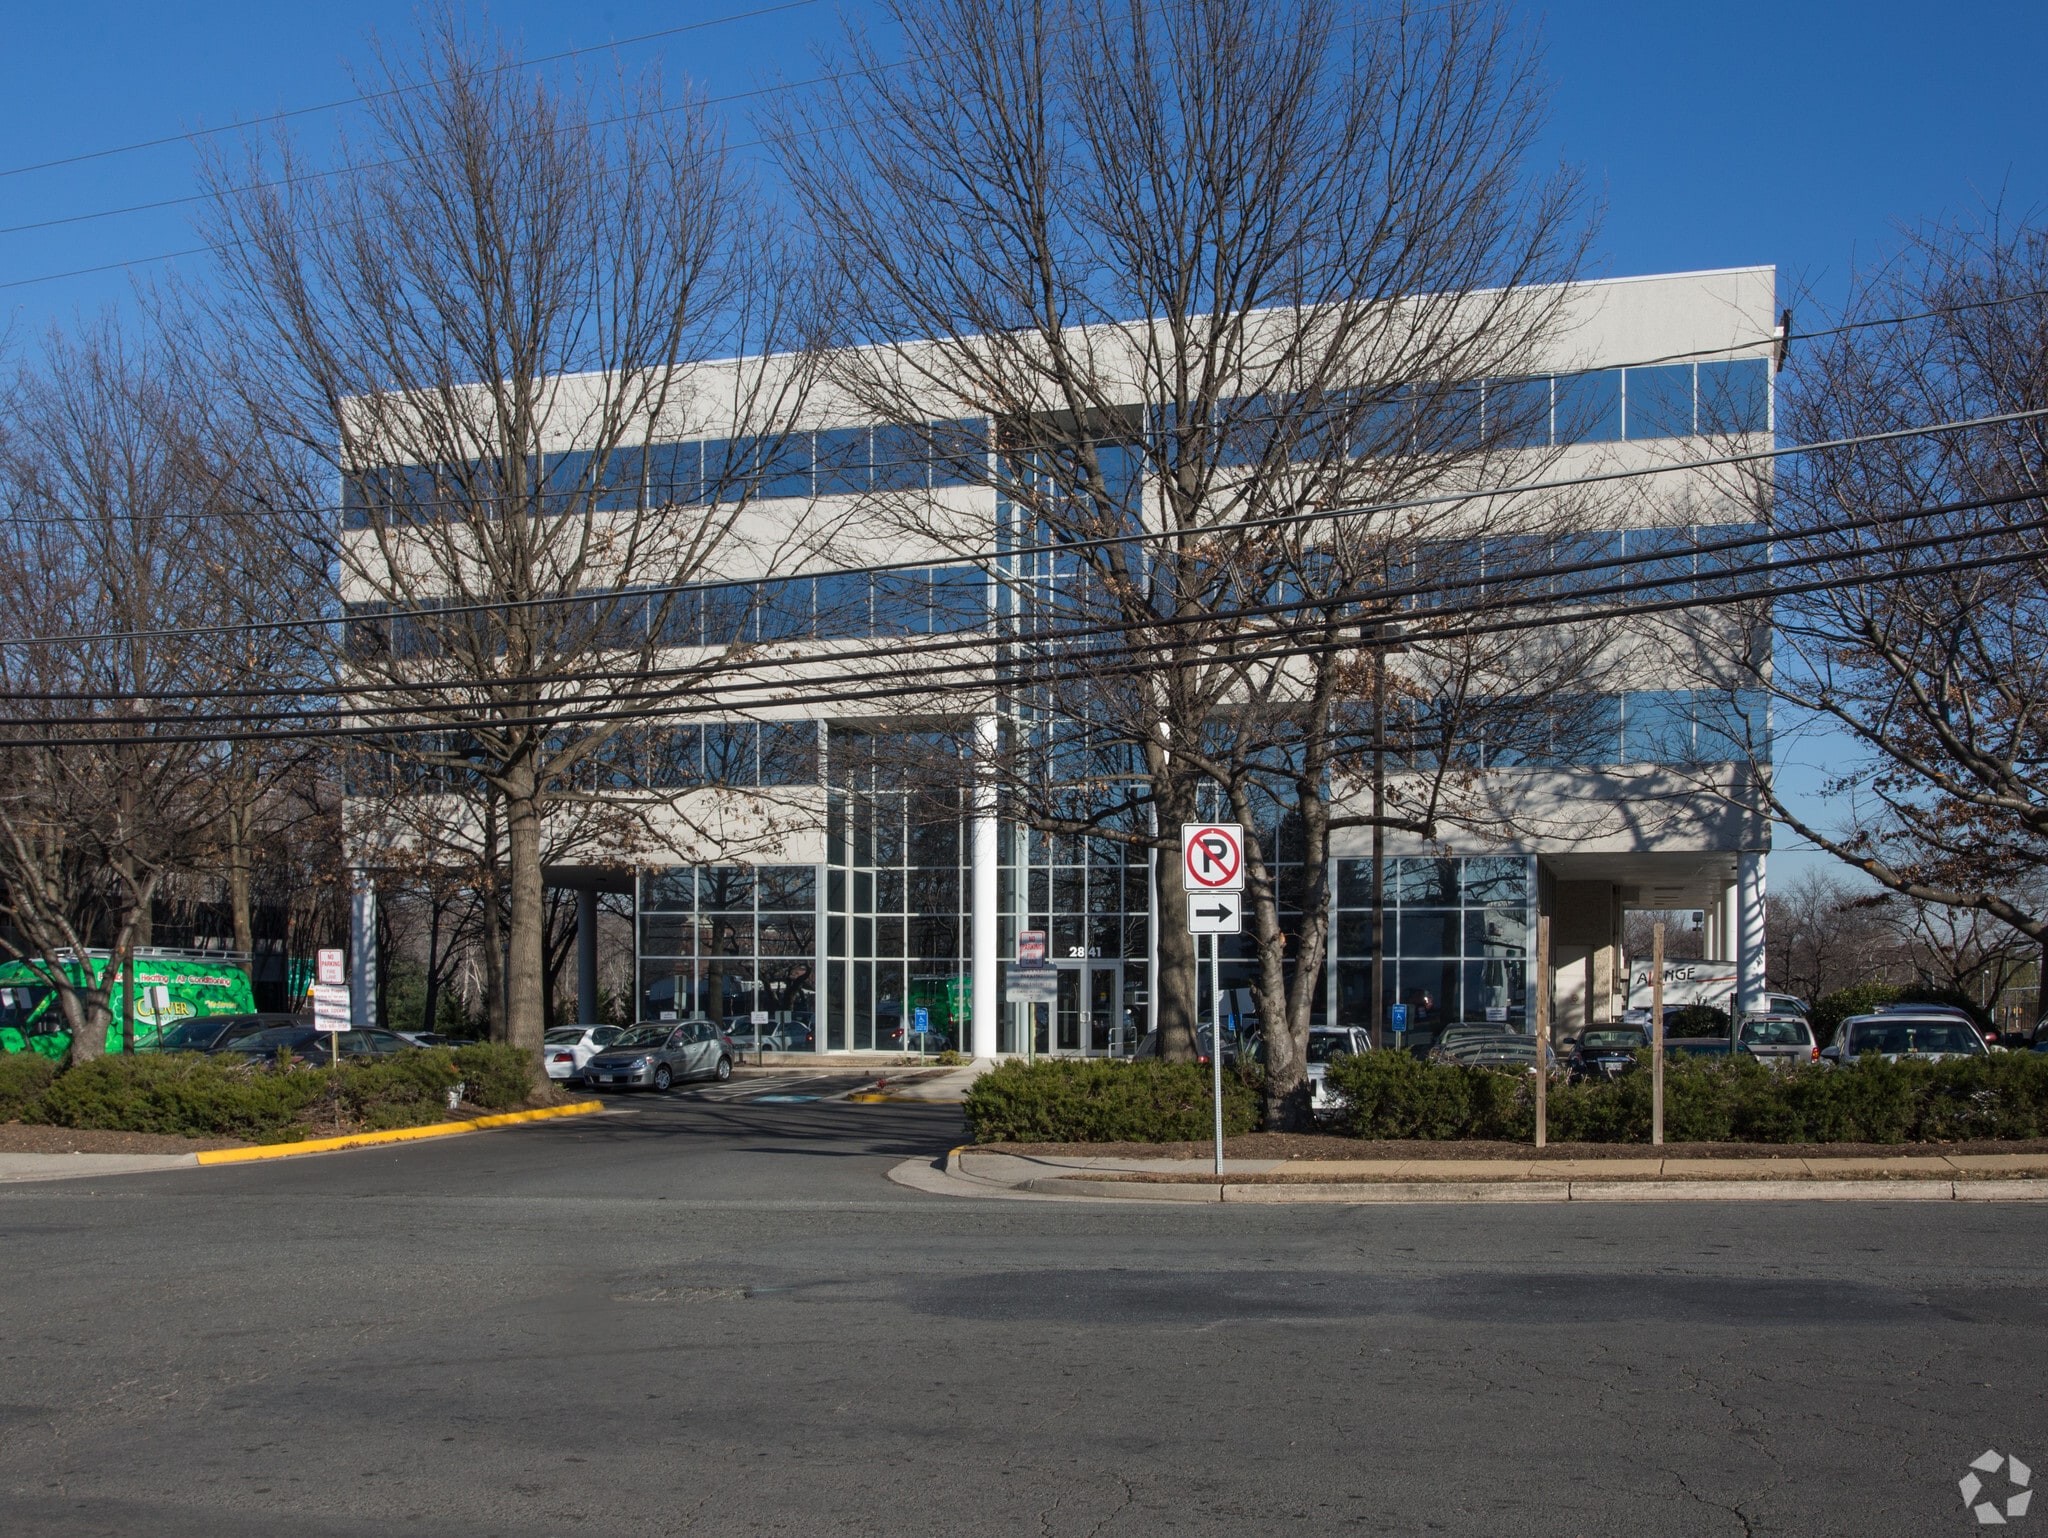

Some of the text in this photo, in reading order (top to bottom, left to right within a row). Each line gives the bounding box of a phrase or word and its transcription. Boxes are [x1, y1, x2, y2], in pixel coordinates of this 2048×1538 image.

[1069, 946, 1102, 958] 2841
[140, 973, 231, 987] Heating Air Conditioning
[1636, 967, 1696, 988] ALNGE
[137, 998, 190, 1017] CVER
